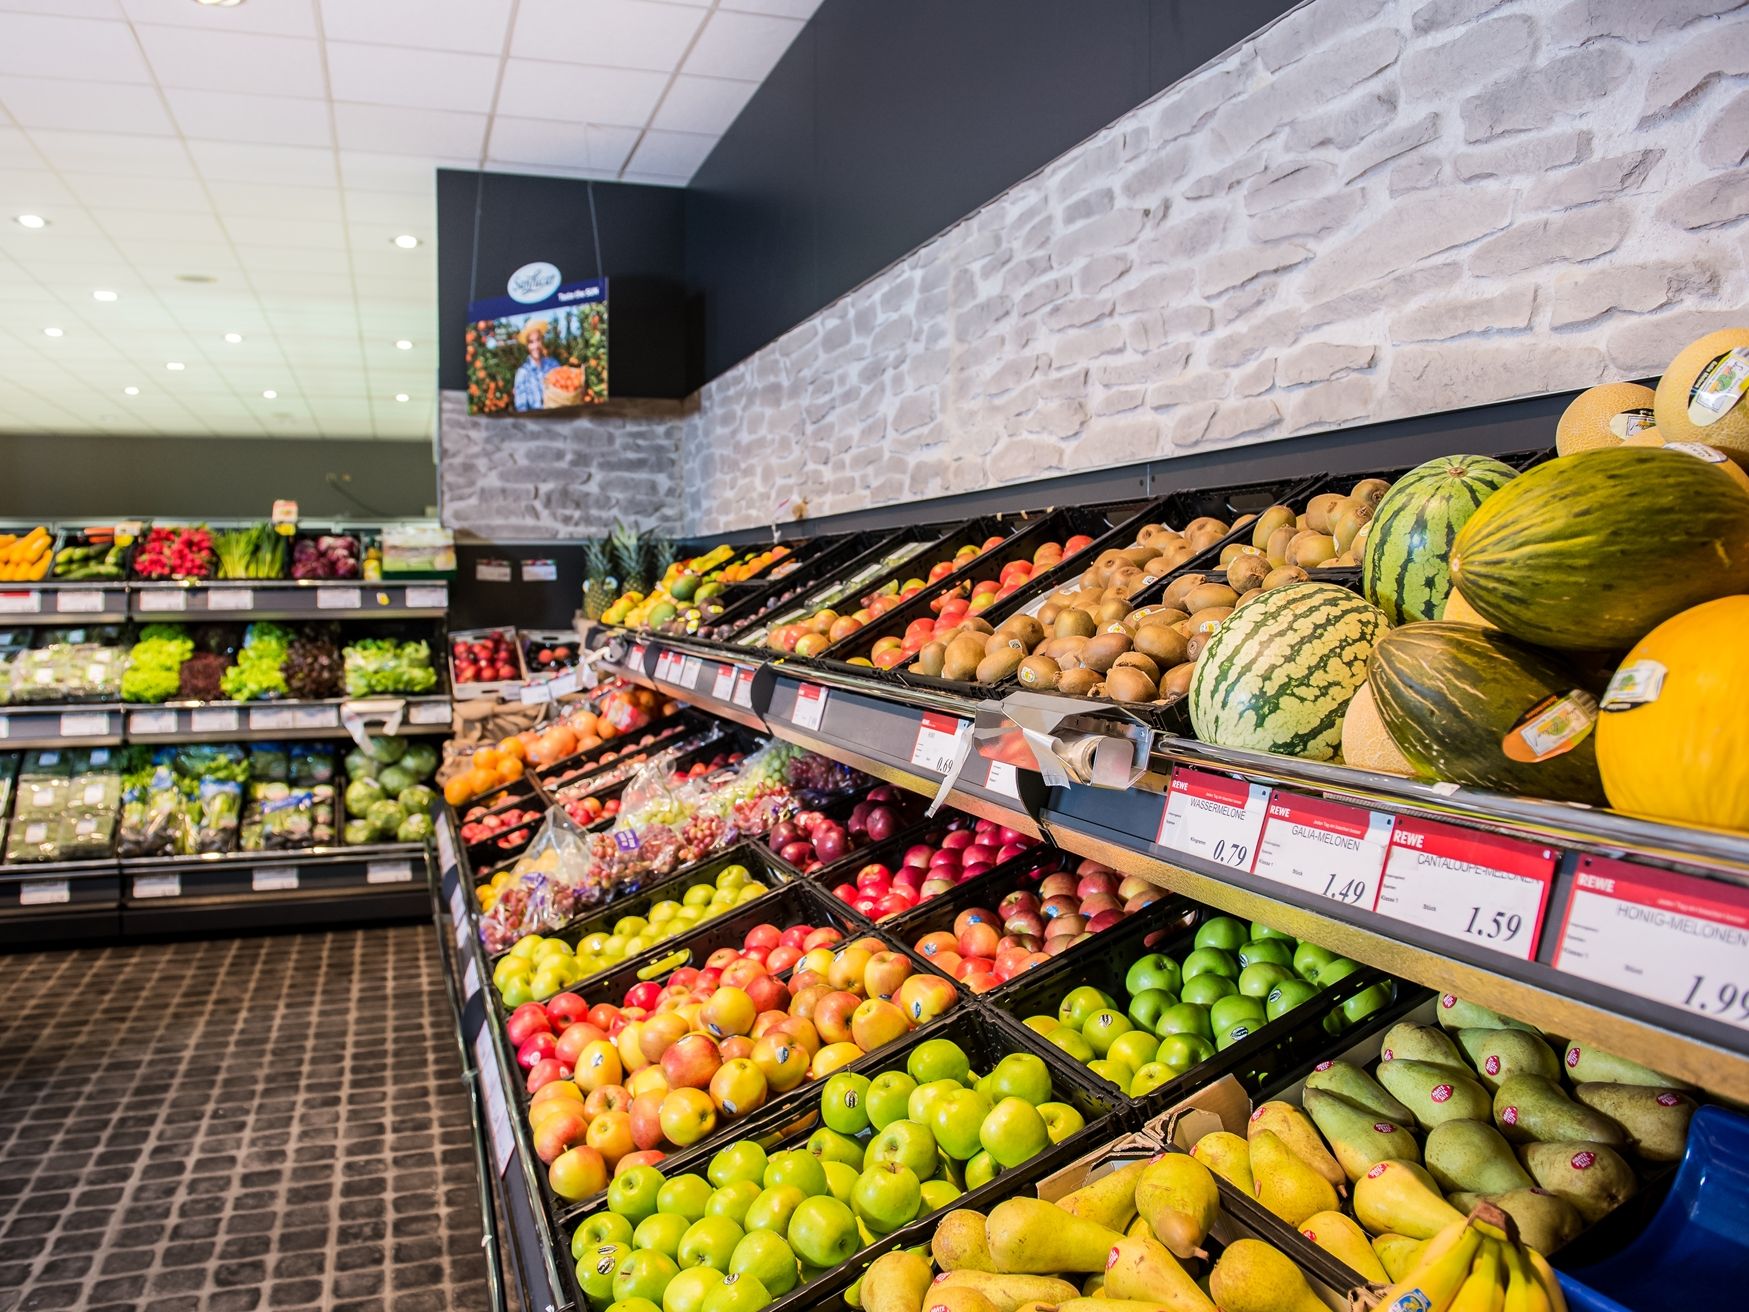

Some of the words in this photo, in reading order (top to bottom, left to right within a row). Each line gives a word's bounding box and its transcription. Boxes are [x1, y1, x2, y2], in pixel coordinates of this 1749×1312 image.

[936, 757, 954, 773] 0.69
[1172, 779, 1189, 791] REWE
[1190, 797, 1246, 820] WASSERMELONE
[1269, 804, 1291, 817] REWE
[1291, 825, 1360, 851] GALIA-MELONEN
[1392, 829, 1424, 849] REWE
[1213, 839, 1248, 867] 0.79
[1322, 873, 1366, 905] 1.49
[1576, 872, 1616, 893] REWE
[1464, 906, 1522, 942] 1.59
[1616, 904, 1749, 947] HONIG-MELONEN
